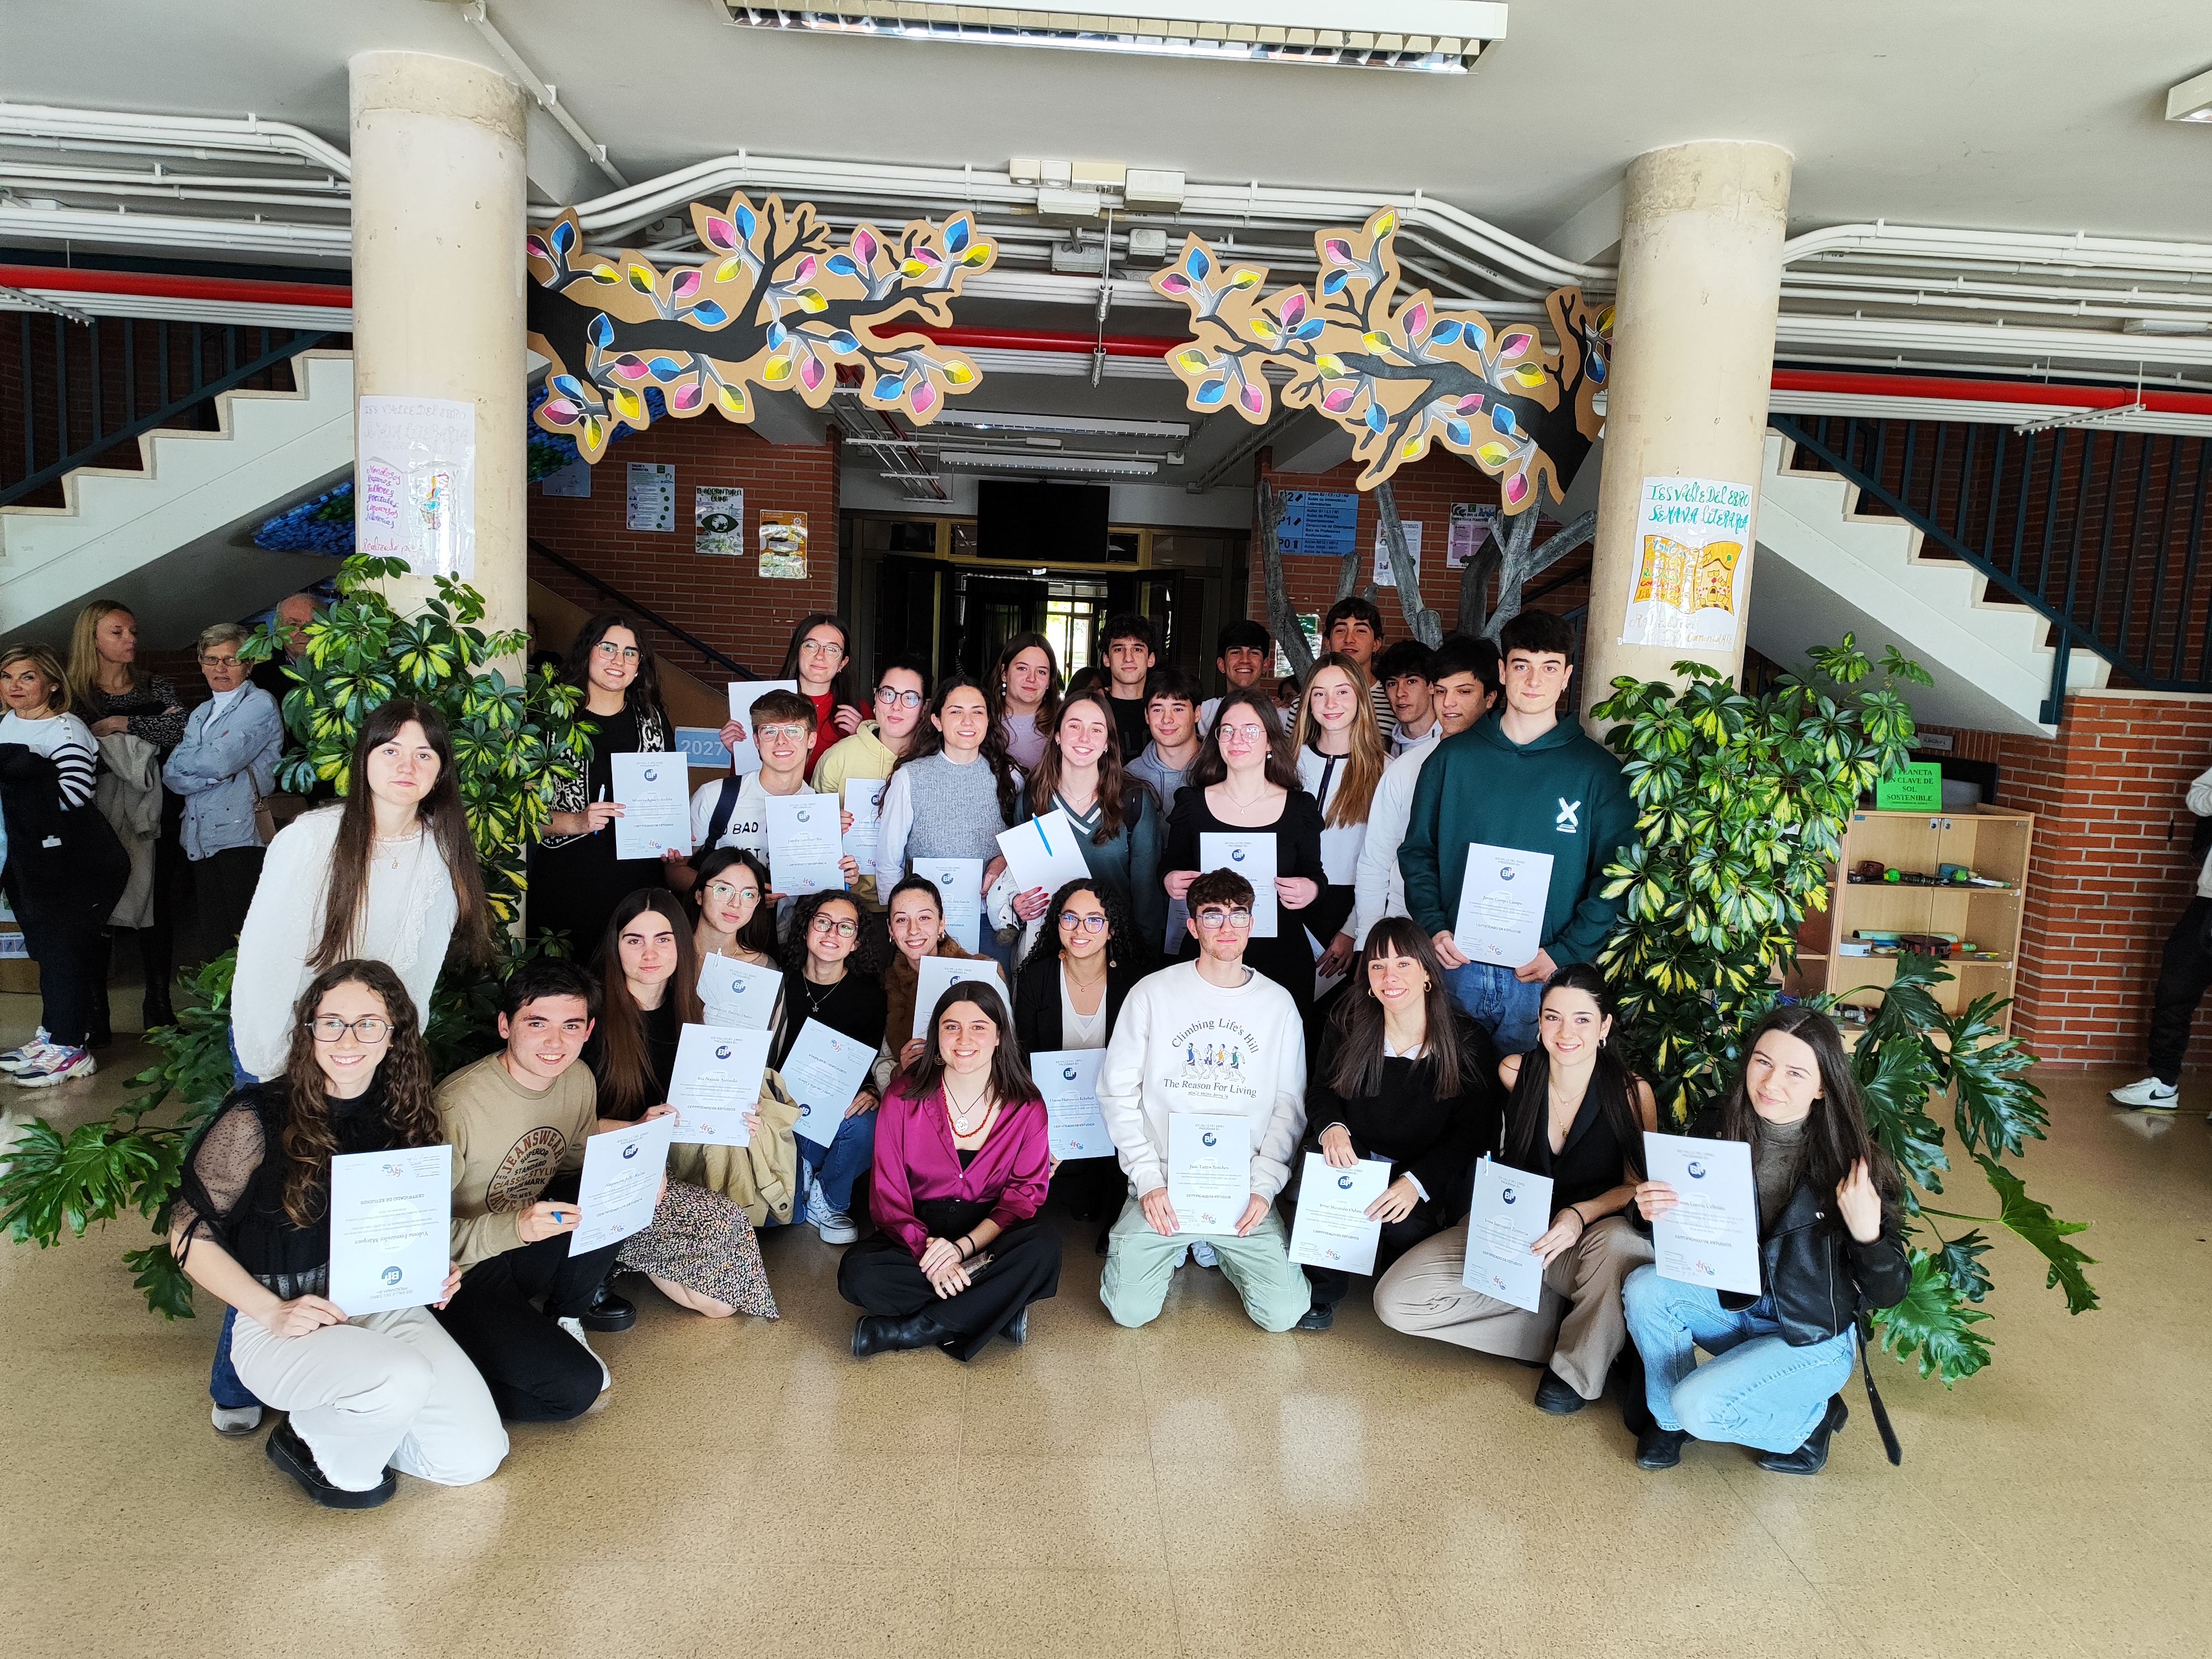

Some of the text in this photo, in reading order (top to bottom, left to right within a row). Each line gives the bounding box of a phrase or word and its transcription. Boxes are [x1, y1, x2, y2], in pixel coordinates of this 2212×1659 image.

[1646, 483, 1673, 502] IES
[1886, 794, 1933, 802] SOSTENIBLE
[733, 822, 759, 834] BAD
[1172, 1018, 1259, 1053] Climbing Life's Hill
[1164, 1078, 1257, 1098] The Reason For Living
[502, 1130, 565, 1175] JEANSWEAR
[520, 1147, 549, 1165] SUPERIOR
[514, 1160, 547, 1176] STANDARD
[493, 1173, 529, 1190] CLASSIC
[505, 1177, 546, 1194] TRADEMARK
[393, 1193, 425, 1202] CERTIFICADO
[489, 1190, 510, 1212] JACK
